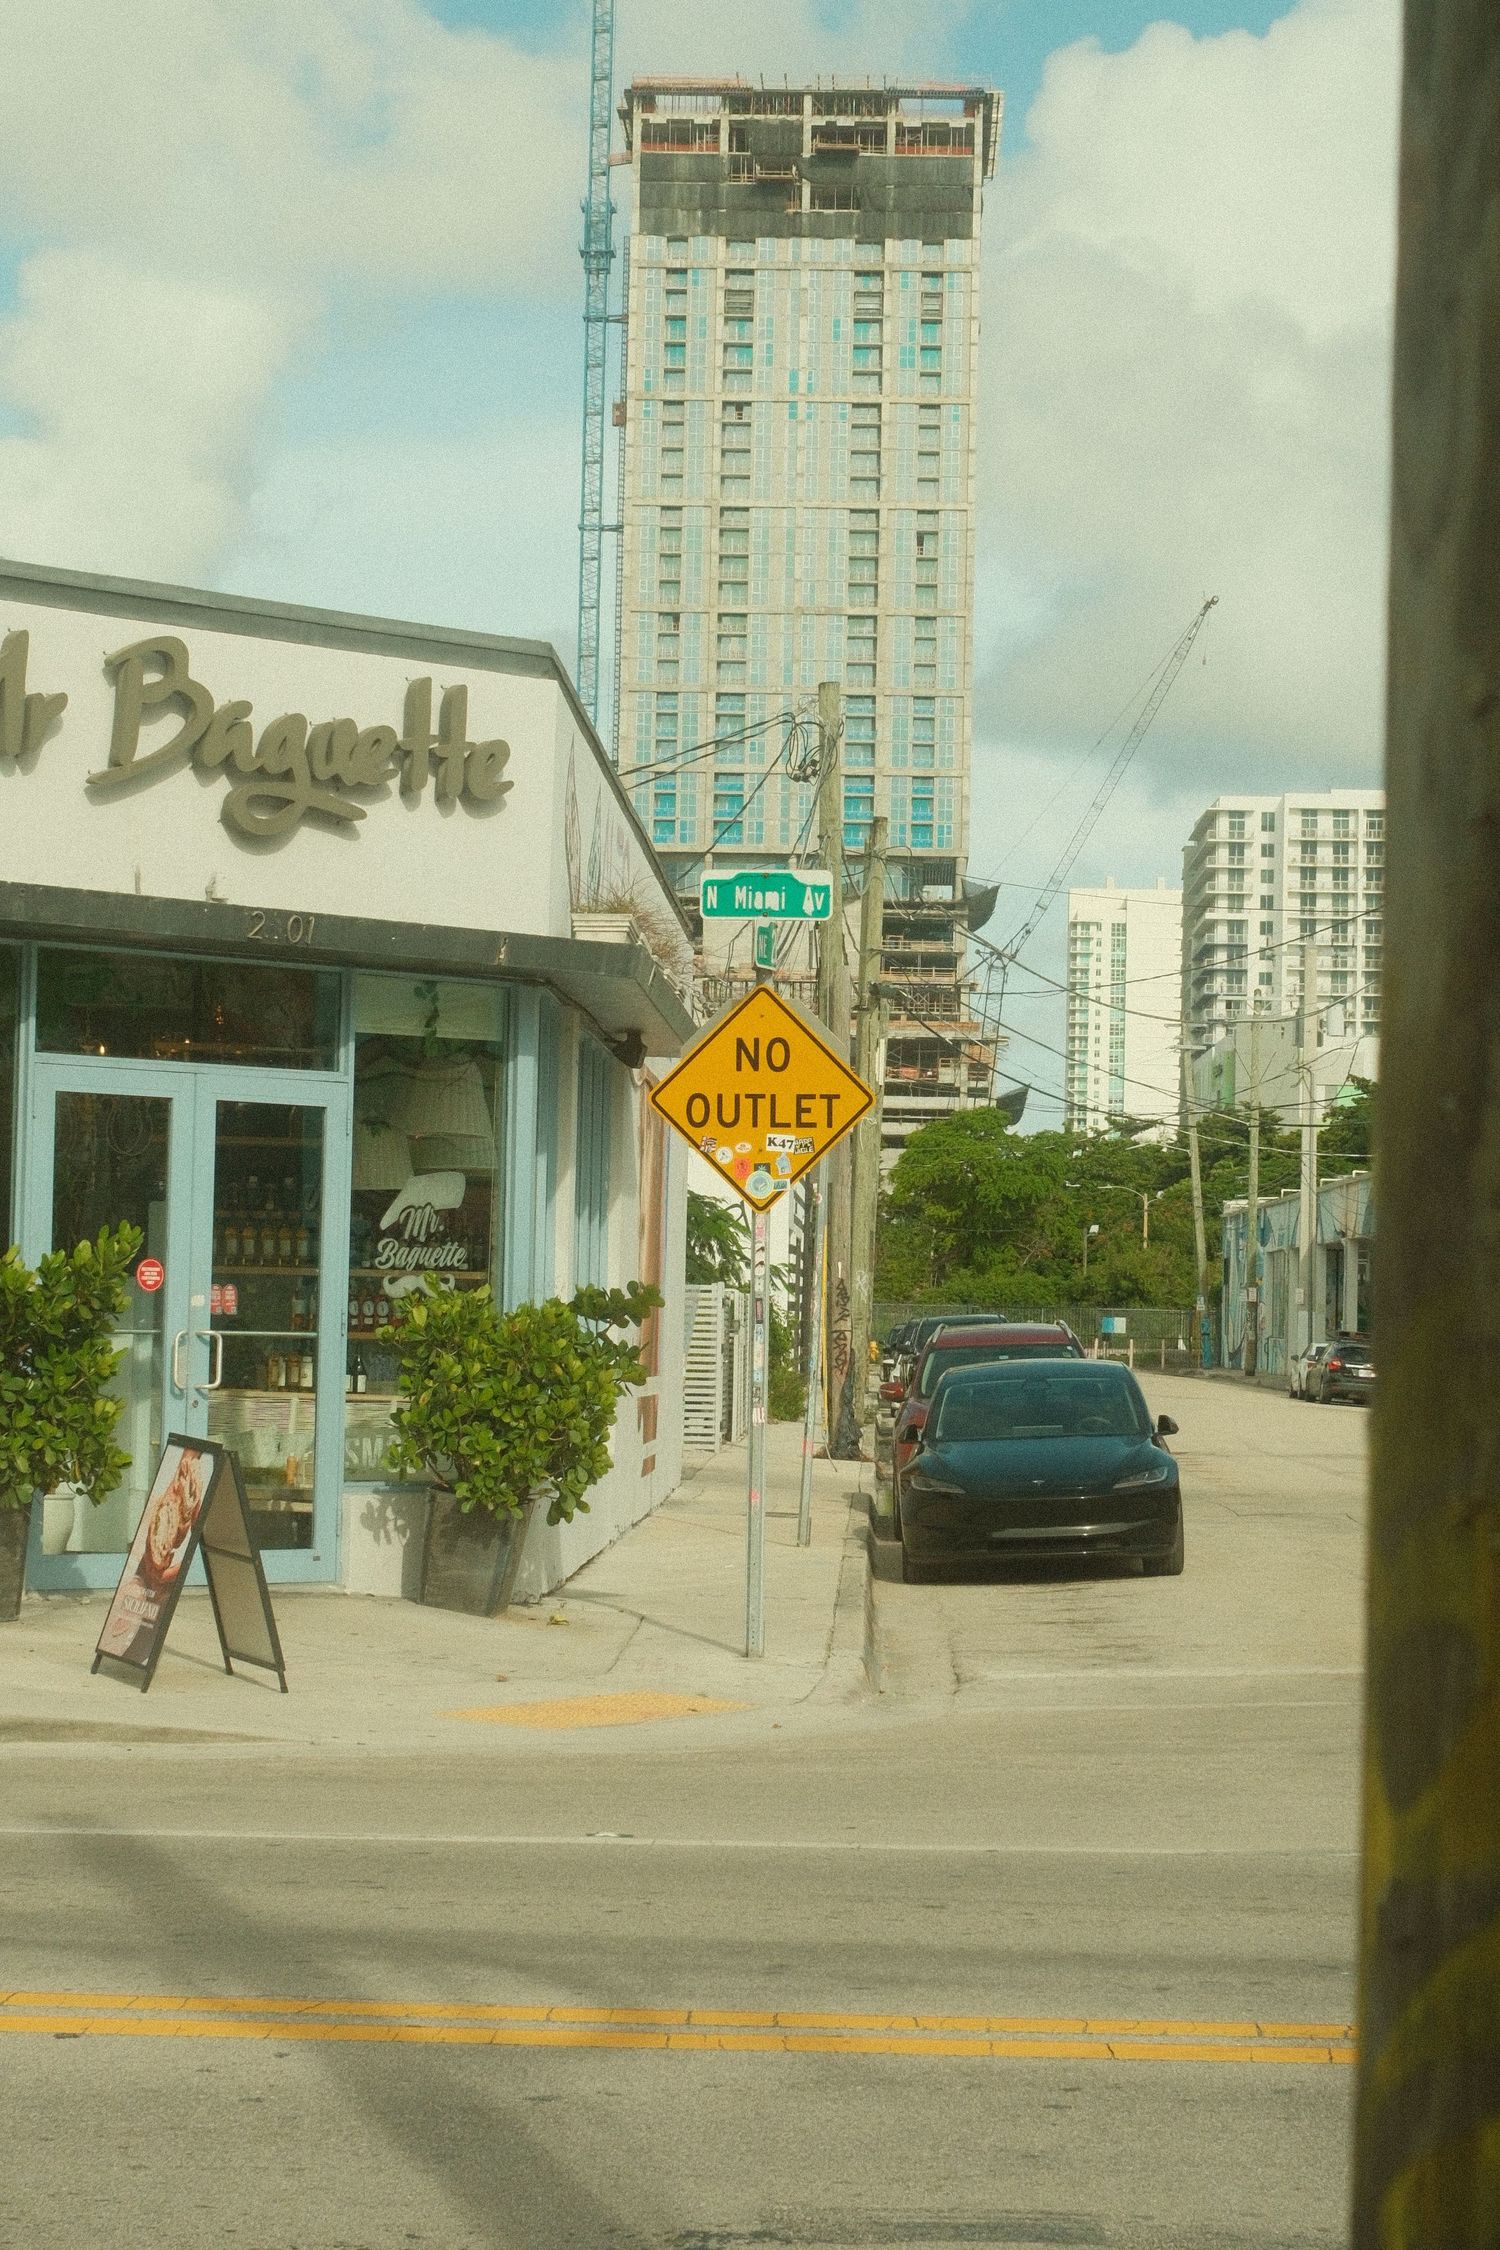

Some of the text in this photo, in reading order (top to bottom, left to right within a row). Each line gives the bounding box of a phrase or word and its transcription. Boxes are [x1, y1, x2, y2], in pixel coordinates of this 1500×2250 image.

[86, 635, 515, 836] Baguette
[706, 885, 825, 916] N Miami Av
[735, 1037, 791, 1073] NO
[685, 1093, 841, 1129] OUTLET
[399, 1203, 445, 1243] Mr.
[374, 1237, 468, 1272] Baguette
